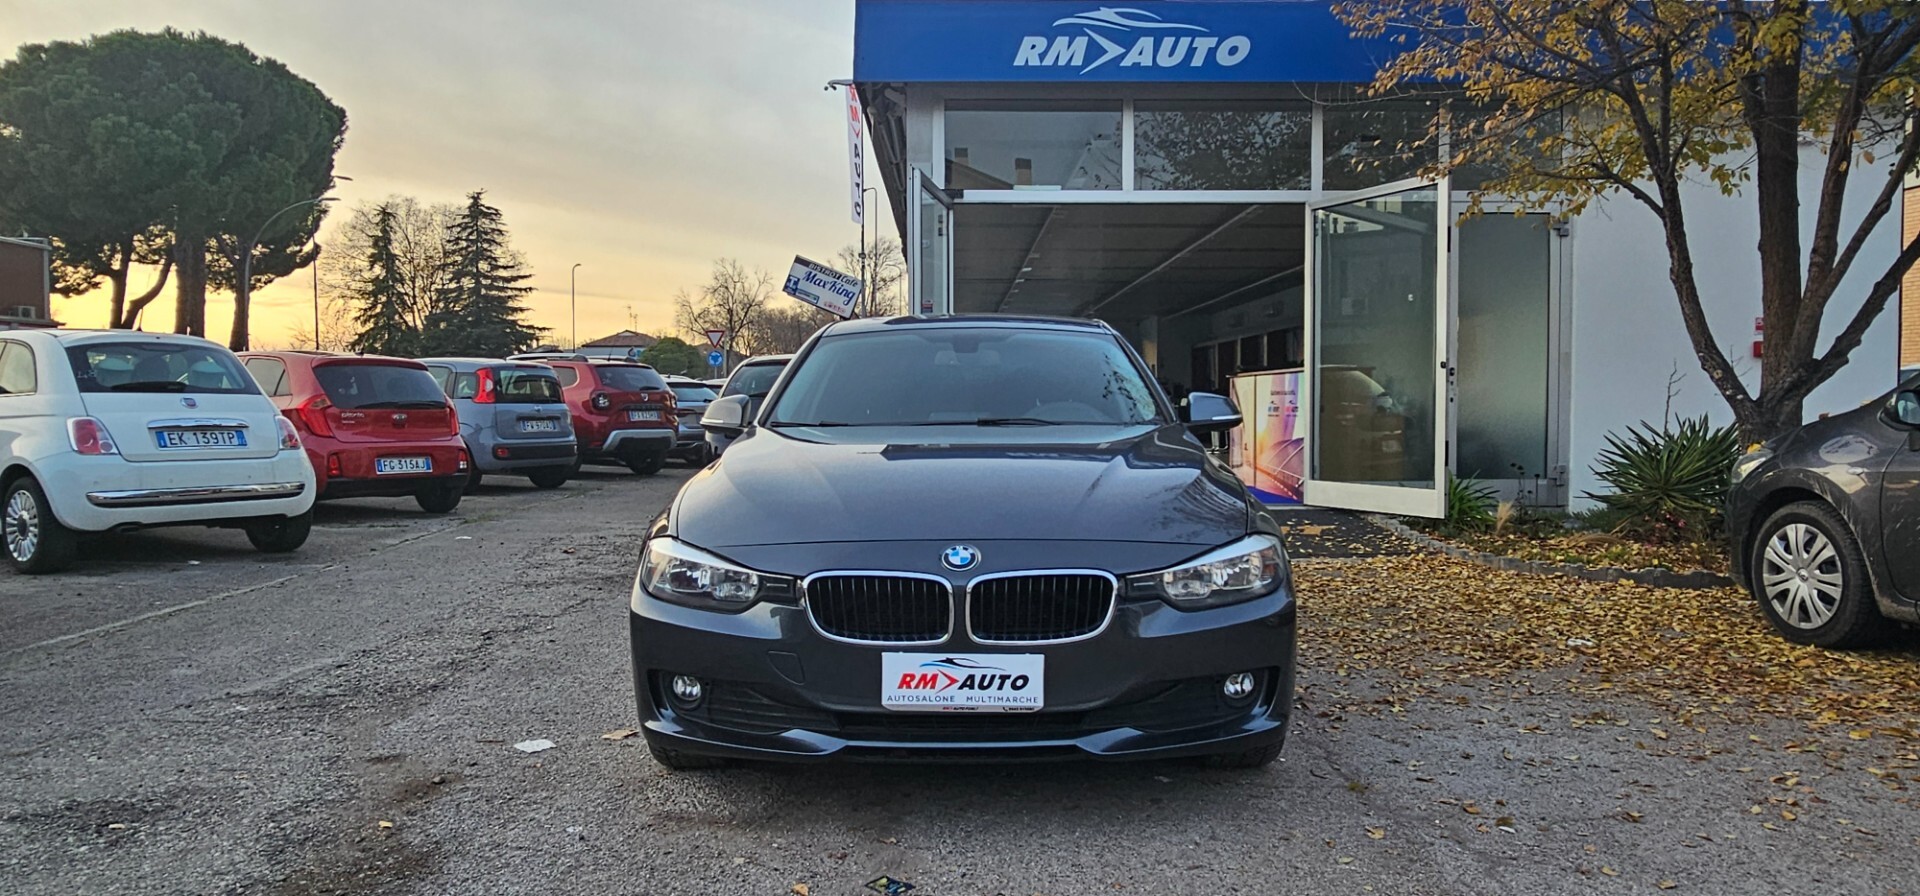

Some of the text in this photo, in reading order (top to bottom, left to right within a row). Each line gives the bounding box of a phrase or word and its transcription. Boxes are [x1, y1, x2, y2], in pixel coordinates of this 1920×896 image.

[1119, 35, 1251, 67] AUTO
[808, 263, 840, 281] BISTROT
[167, 432, 235, 446] EK 139TP
[383, 459, 425, 470] FG 315AJ
[957, 674, 1030, 691] AUTO
[887, 695, 1038, 704] AUTOSALONE MULTIMARCHE
